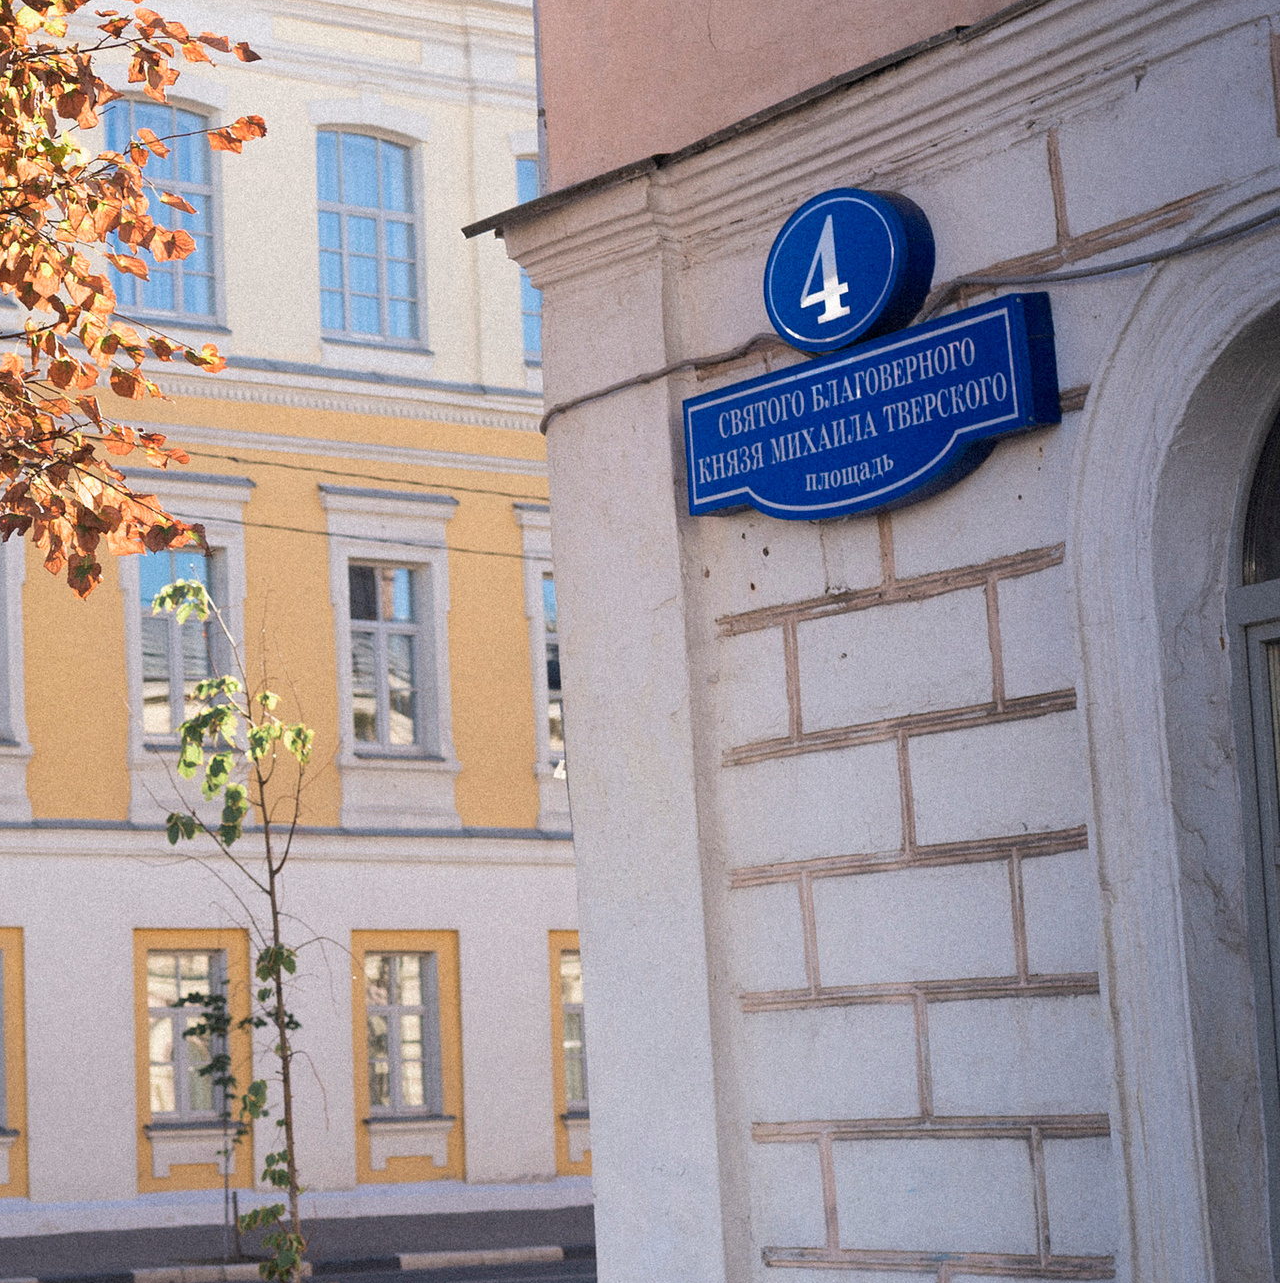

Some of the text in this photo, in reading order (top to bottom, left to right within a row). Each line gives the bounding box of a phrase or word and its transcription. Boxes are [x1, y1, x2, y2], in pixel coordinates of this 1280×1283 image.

[800, 214, 850, 324] 4
[697, 371, 1008, 485] КНЯЗЯ МИХАИЛА ТВЕРСКОГО
[718, 336, 976, 439] СВЯТОГО БЛАГОВЕРНОГО
[805, 454, 895, 492] площадь
